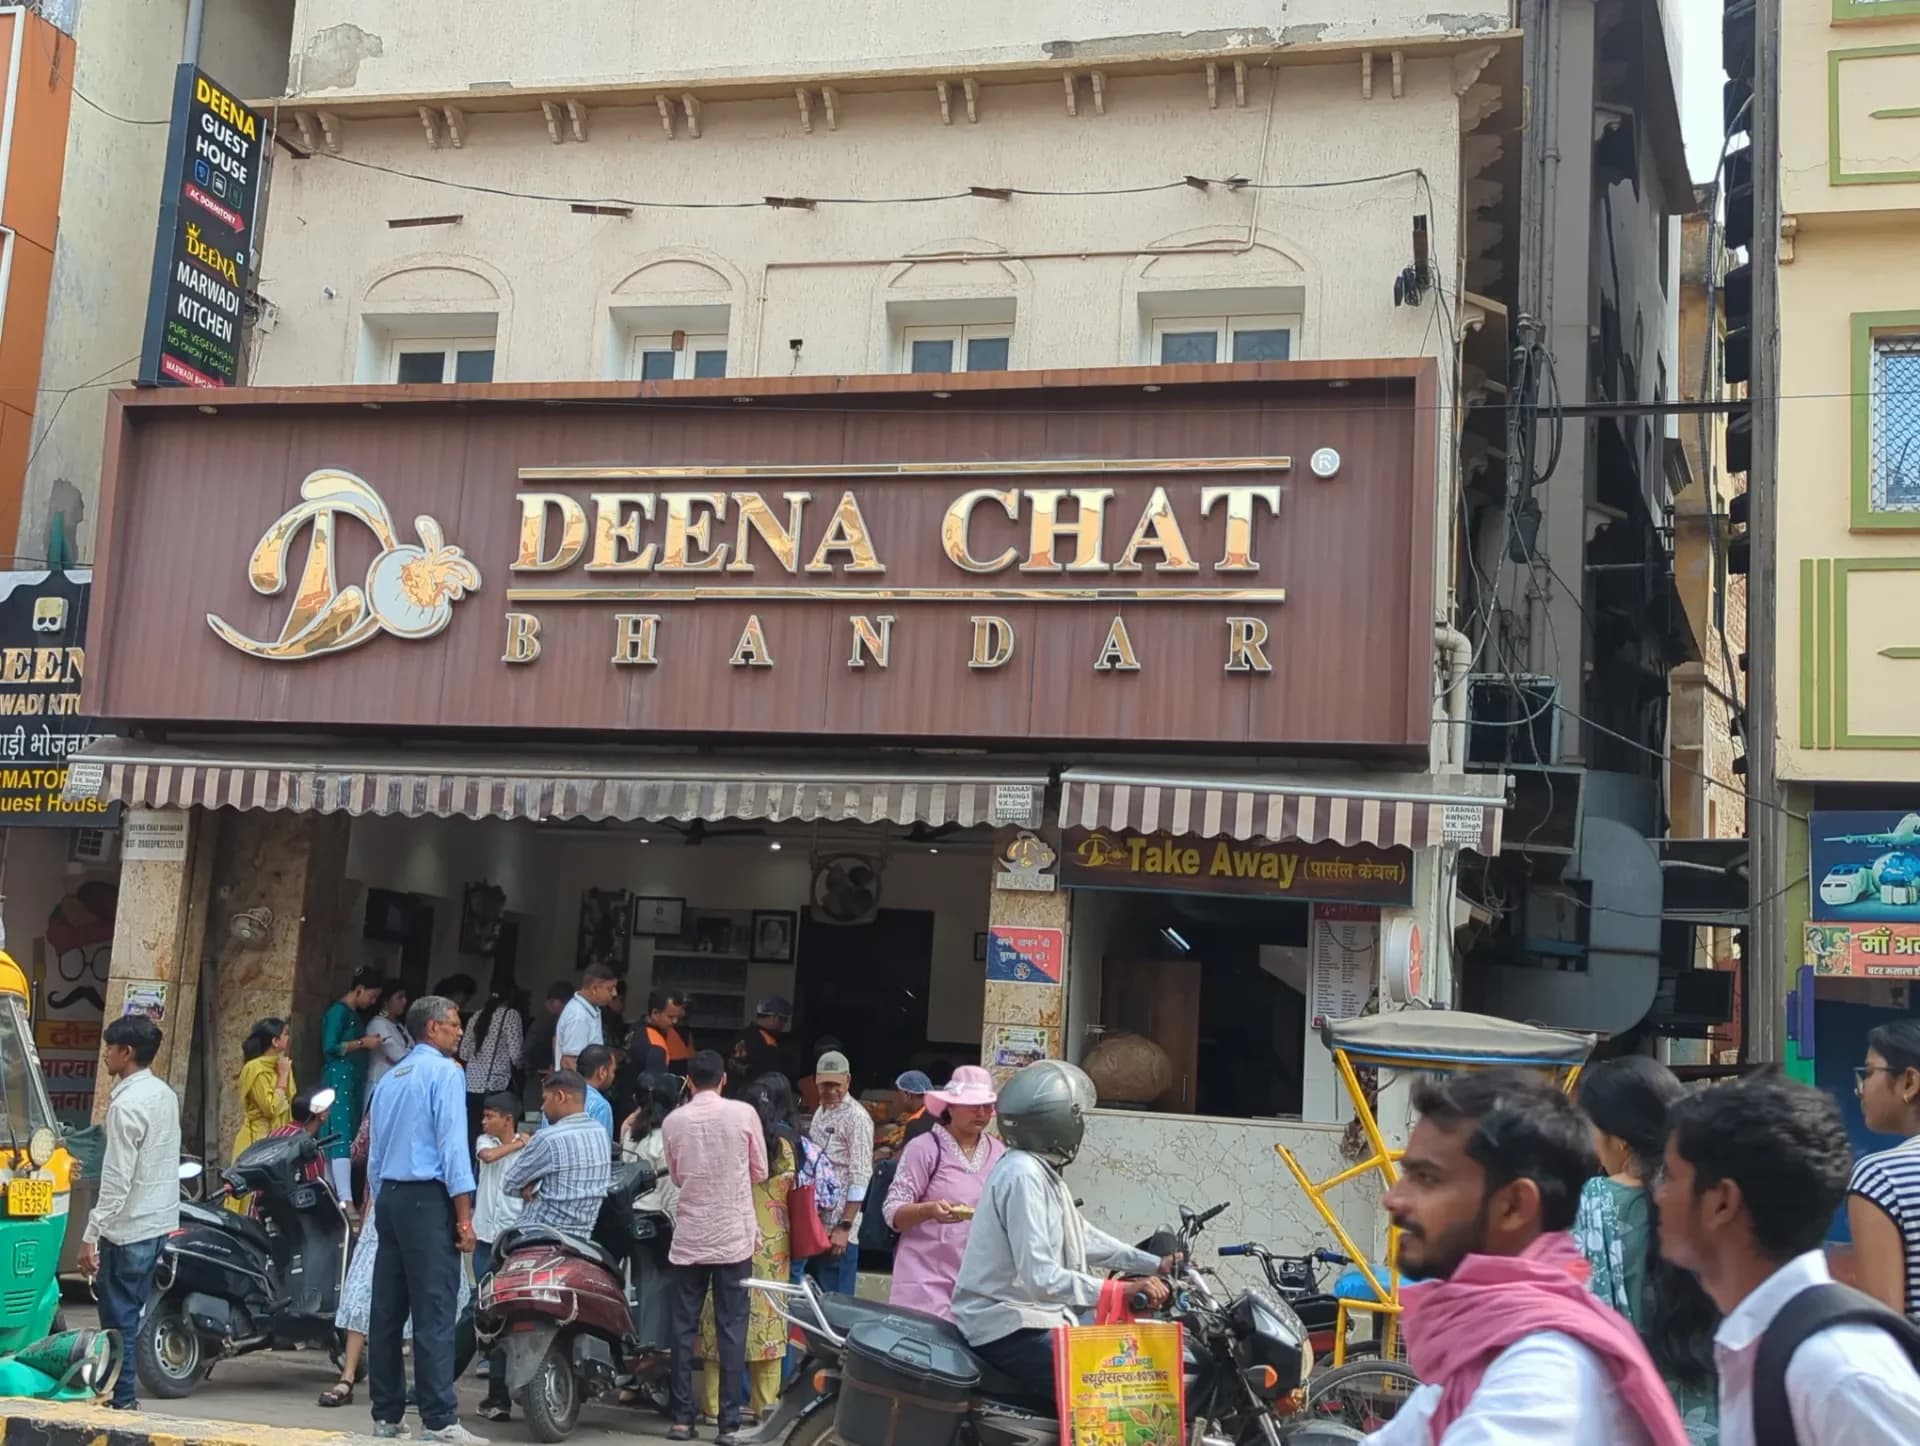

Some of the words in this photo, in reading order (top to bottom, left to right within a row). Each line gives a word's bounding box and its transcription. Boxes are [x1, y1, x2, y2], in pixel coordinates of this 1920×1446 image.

[197, 77, 255, 141] DEENA
[202, 113, 249, 158] GUEST
[196, 135, 247, 184] HOUSE
[190, 189, 200, 200] AC
[200, 195, 236, 224] DORMITORY
[186, 235, 239, 287] DEENA
[177, 260, 239, 316] MARWADI
[168, 334, 179, 346] NO
[178, 293, 233, 343] KITCHEN
[169, 321, 188, 339] PURE
[191, 332, 234, 365] VEGETARIAN
[509, 487, 886, 573] DEENA
[941, 485, 1283, 573] CHAT
[501, 611, 1274, 672] BHANDAR
[0, 793, 42, 812] uest
[1445, 806, 1482, 814] VARANASI
[1445, 813, 1482, 821] AWNINGS
[1460, 821, 1481, 831] Singh
[1127, 837, 1200, 876] Take
[1209, 841, 1299, 889] Away
